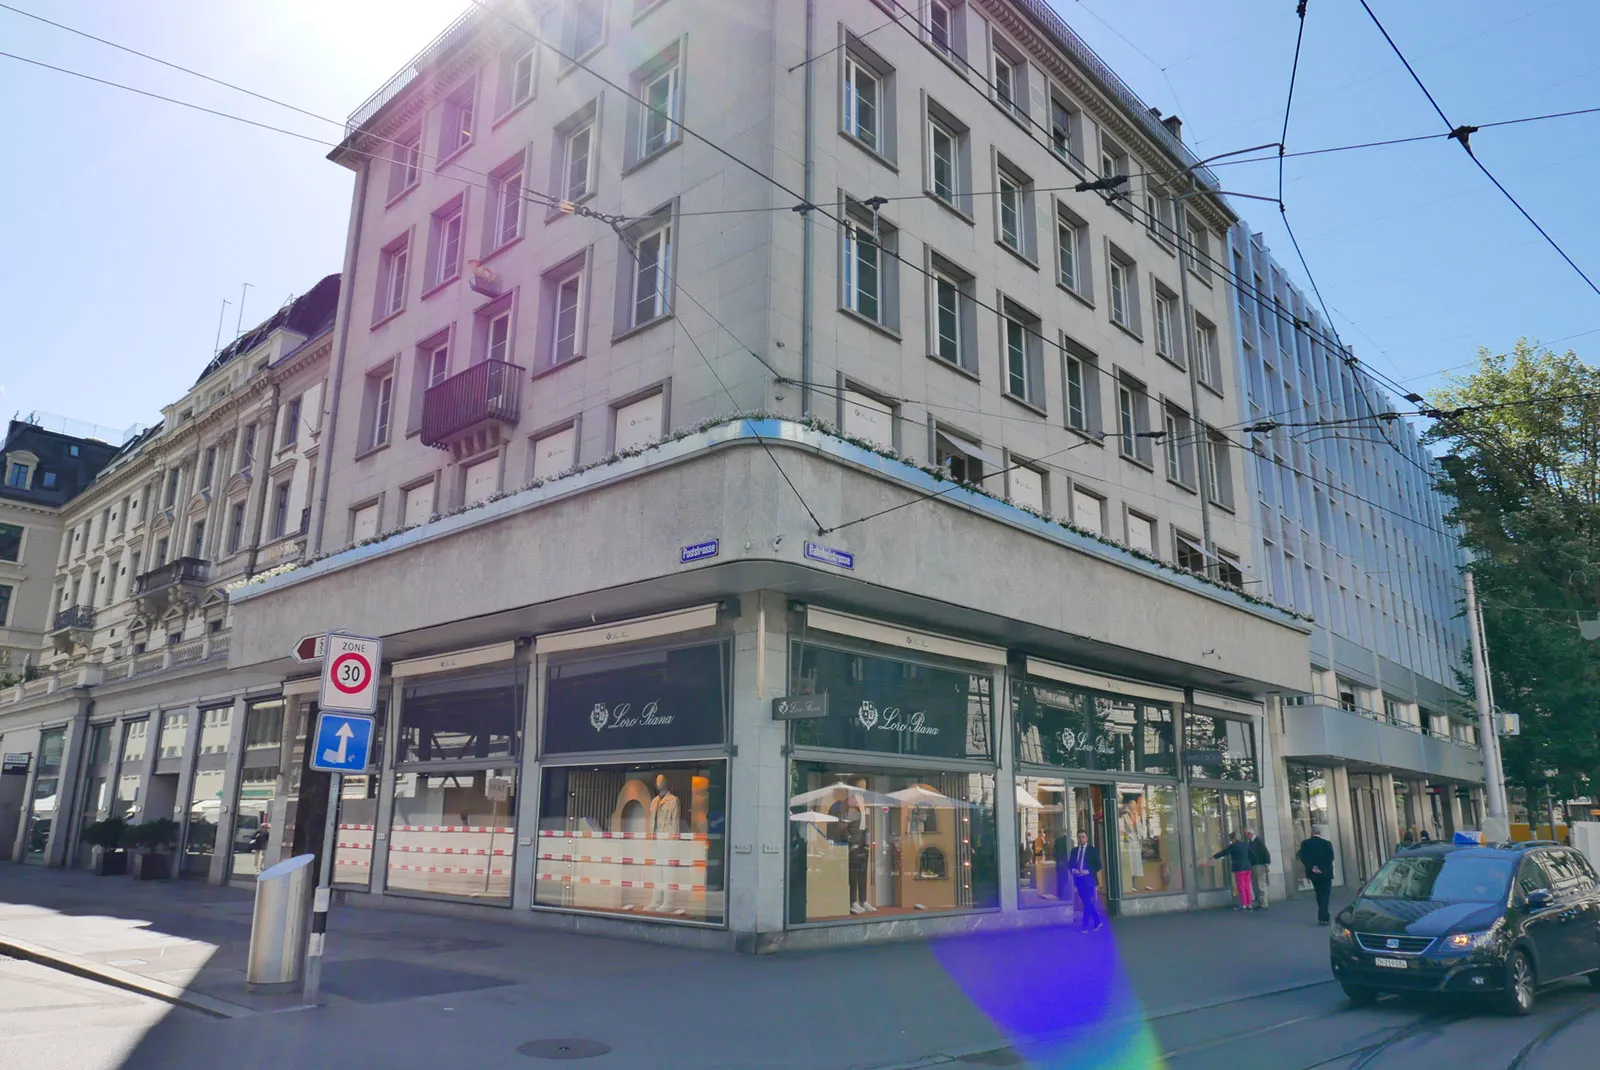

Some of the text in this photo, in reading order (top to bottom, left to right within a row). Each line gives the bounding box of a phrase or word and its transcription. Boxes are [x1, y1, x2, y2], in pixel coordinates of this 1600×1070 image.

[683, 544, 715, 559] Poststrasse
[342, 642, 366, 653] ZONE
[342, 664, 360, 682] 30
[608, 698, 675, 728] Loro Piana
[878, 706, 940, 735] Loro Piana
[1075, 731, 1093, 751] Loro
